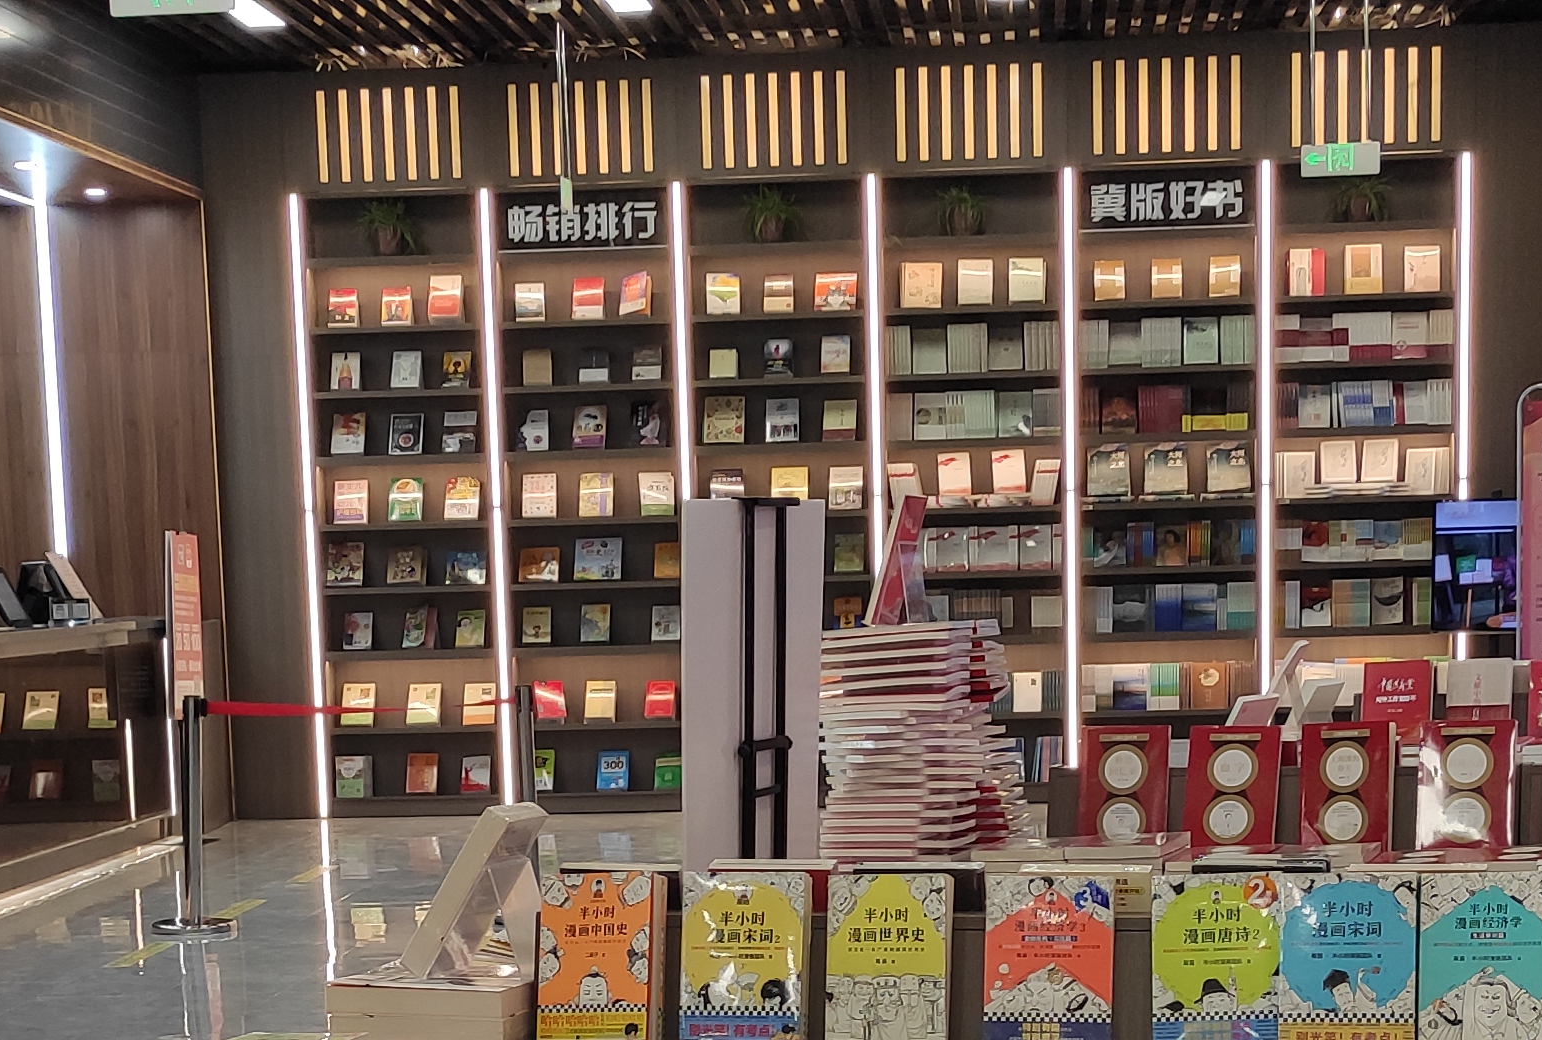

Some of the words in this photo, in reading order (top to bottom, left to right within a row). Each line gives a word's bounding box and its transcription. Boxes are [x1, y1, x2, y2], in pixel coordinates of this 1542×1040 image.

[1090, 179, 1244, 222] 冀版好书
[507, 201, 658, 242] 畅销排行
[604, 760, 624, 770] 300
[579, 905, 616, 920] 半小时
[864, 907, 909, 923] 半小时
[1192, 907, 1242, 924] 半小时
[1322, 901, 1373, 918] 半小时
[1469, 903, 1509, 915] 半小时
[719, 911, 766, 927] 半小时
[1455, 916, 1523, 930] 漫画经济学
[564, 922, 629, 938] 漫画中国史
[847, 926, 926, 943] 漫画世界史
[1183, 927, 1261, 944] 漫画唐诗2
[1313, 921, 1382, 938] 漫画宋词
